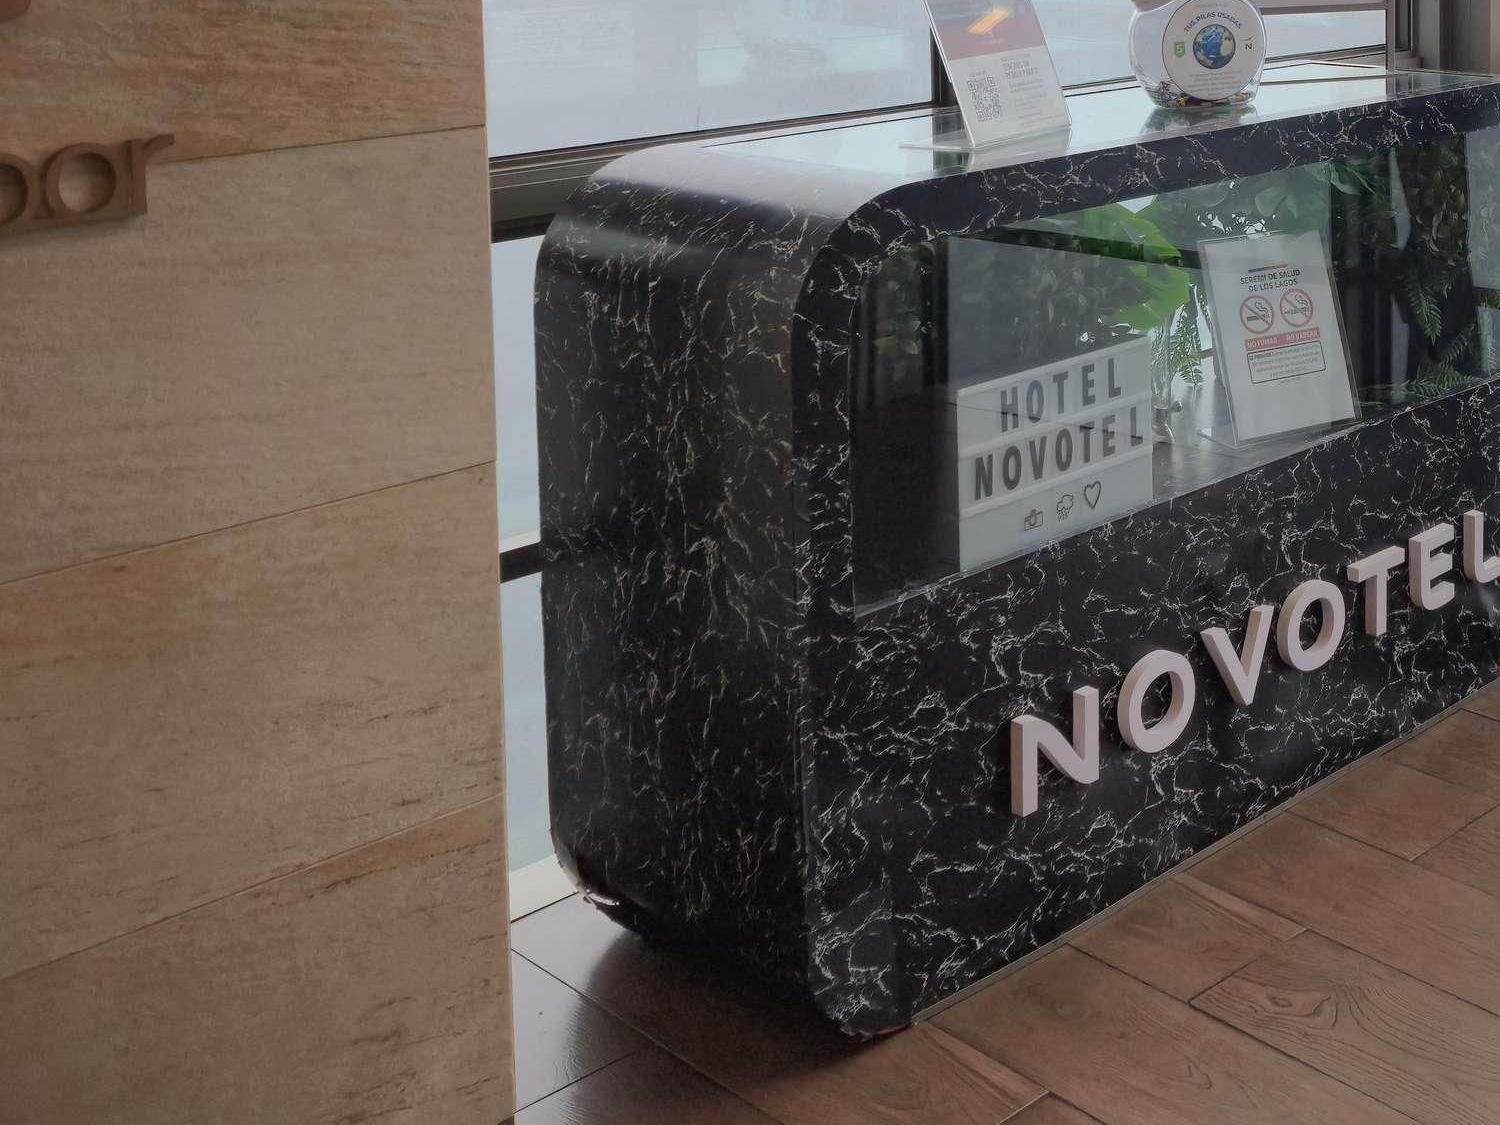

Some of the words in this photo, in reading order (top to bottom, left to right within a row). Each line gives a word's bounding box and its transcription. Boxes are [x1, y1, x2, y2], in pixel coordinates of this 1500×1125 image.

[1248, 283, 1258, 292] DE
[1269, 272, 1278, 281] DE
[1279, 269, 1301, 279] SALUD
[1000, 357, 1122, 433] HOTEL
[974, 406, 1144, 501] NOVOTEL
